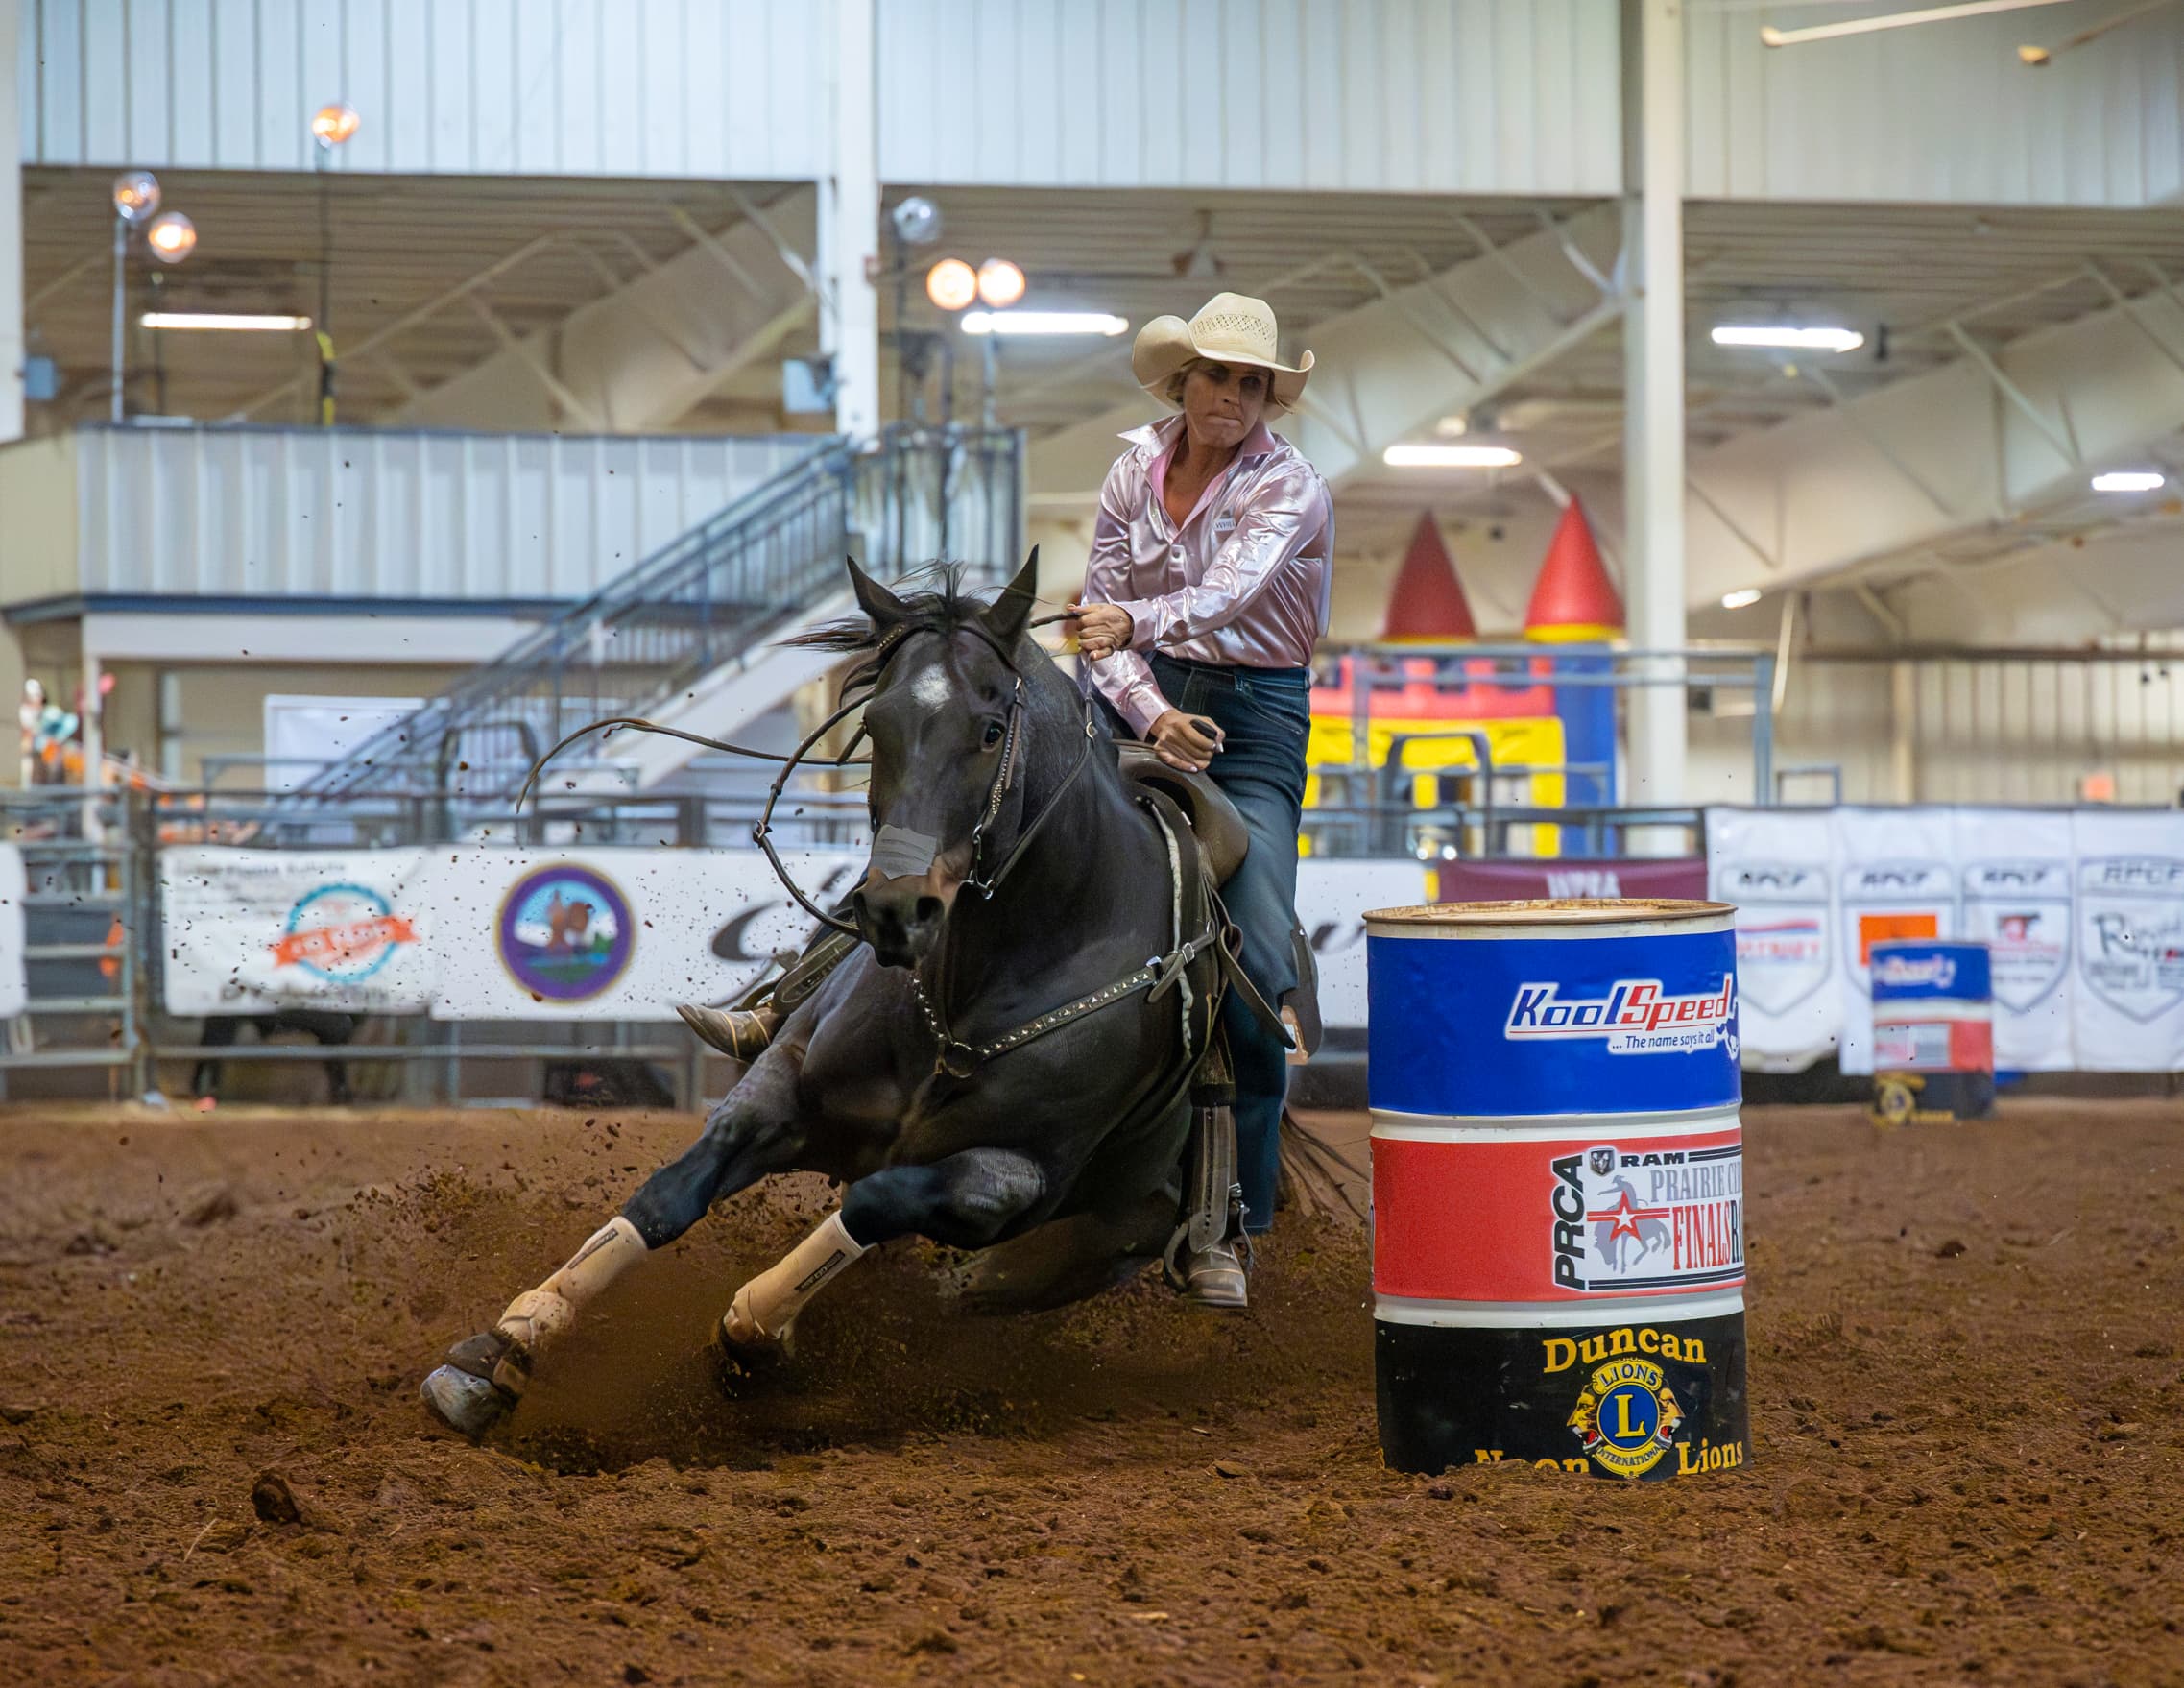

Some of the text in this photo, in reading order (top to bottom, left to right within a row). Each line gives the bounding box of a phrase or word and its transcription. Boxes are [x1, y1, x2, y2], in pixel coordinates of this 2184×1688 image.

[1511, 978, 1731, 1031] KoolSpeed
[1626, 1035, 1646, 1049] The
[1648, 1036, 1678, 1047] name
[1680, 1035, 1697, 1048] says
[1698, 1031, 1705, 1044] it
[1705, 1029, 1715, 1043] all
[1620, 1151, 1685, 1168] RAM
[1650, 1164, 1725, 1203] PRAIRIE
[1552, 1154, 1586, 1290] PRCA
[1542, 1327, 1707, 1373] Duncan
[1599, 1363, 1658, 1386] LIONS
[1614, 1393, 1647, 1438] L
[1674, 1437, 1743, 1476] Lions
